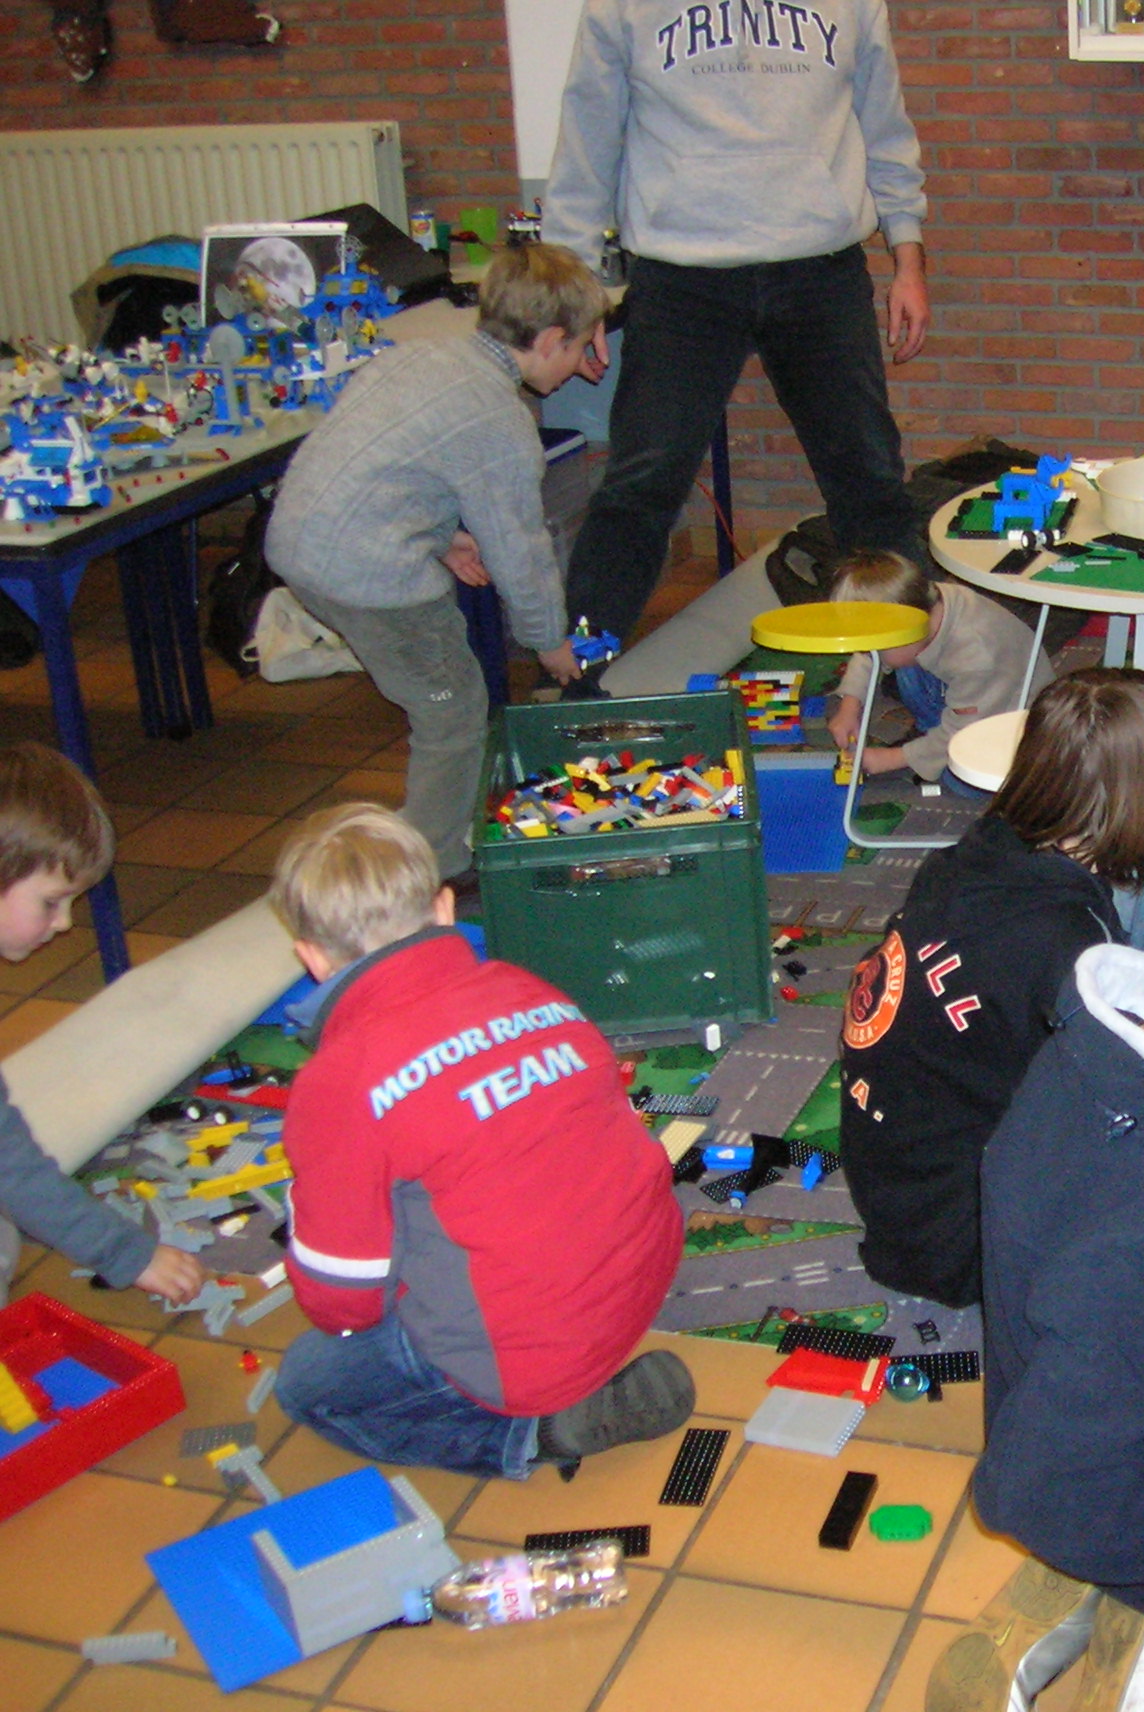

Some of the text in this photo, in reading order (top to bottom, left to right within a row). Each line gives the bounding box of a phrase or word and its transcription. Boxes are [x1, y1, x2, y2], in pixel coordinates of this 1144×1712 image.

[656, 0, 839, 71] TRINITY
[691, 61, 812, 75] COLLEGE DUBLIN
[885, 954, 903, 1007] CRUZ
[369, 1001, 588, 1121] MOTOR RACIN
[456, 1042, 589, 1122] TEAM
